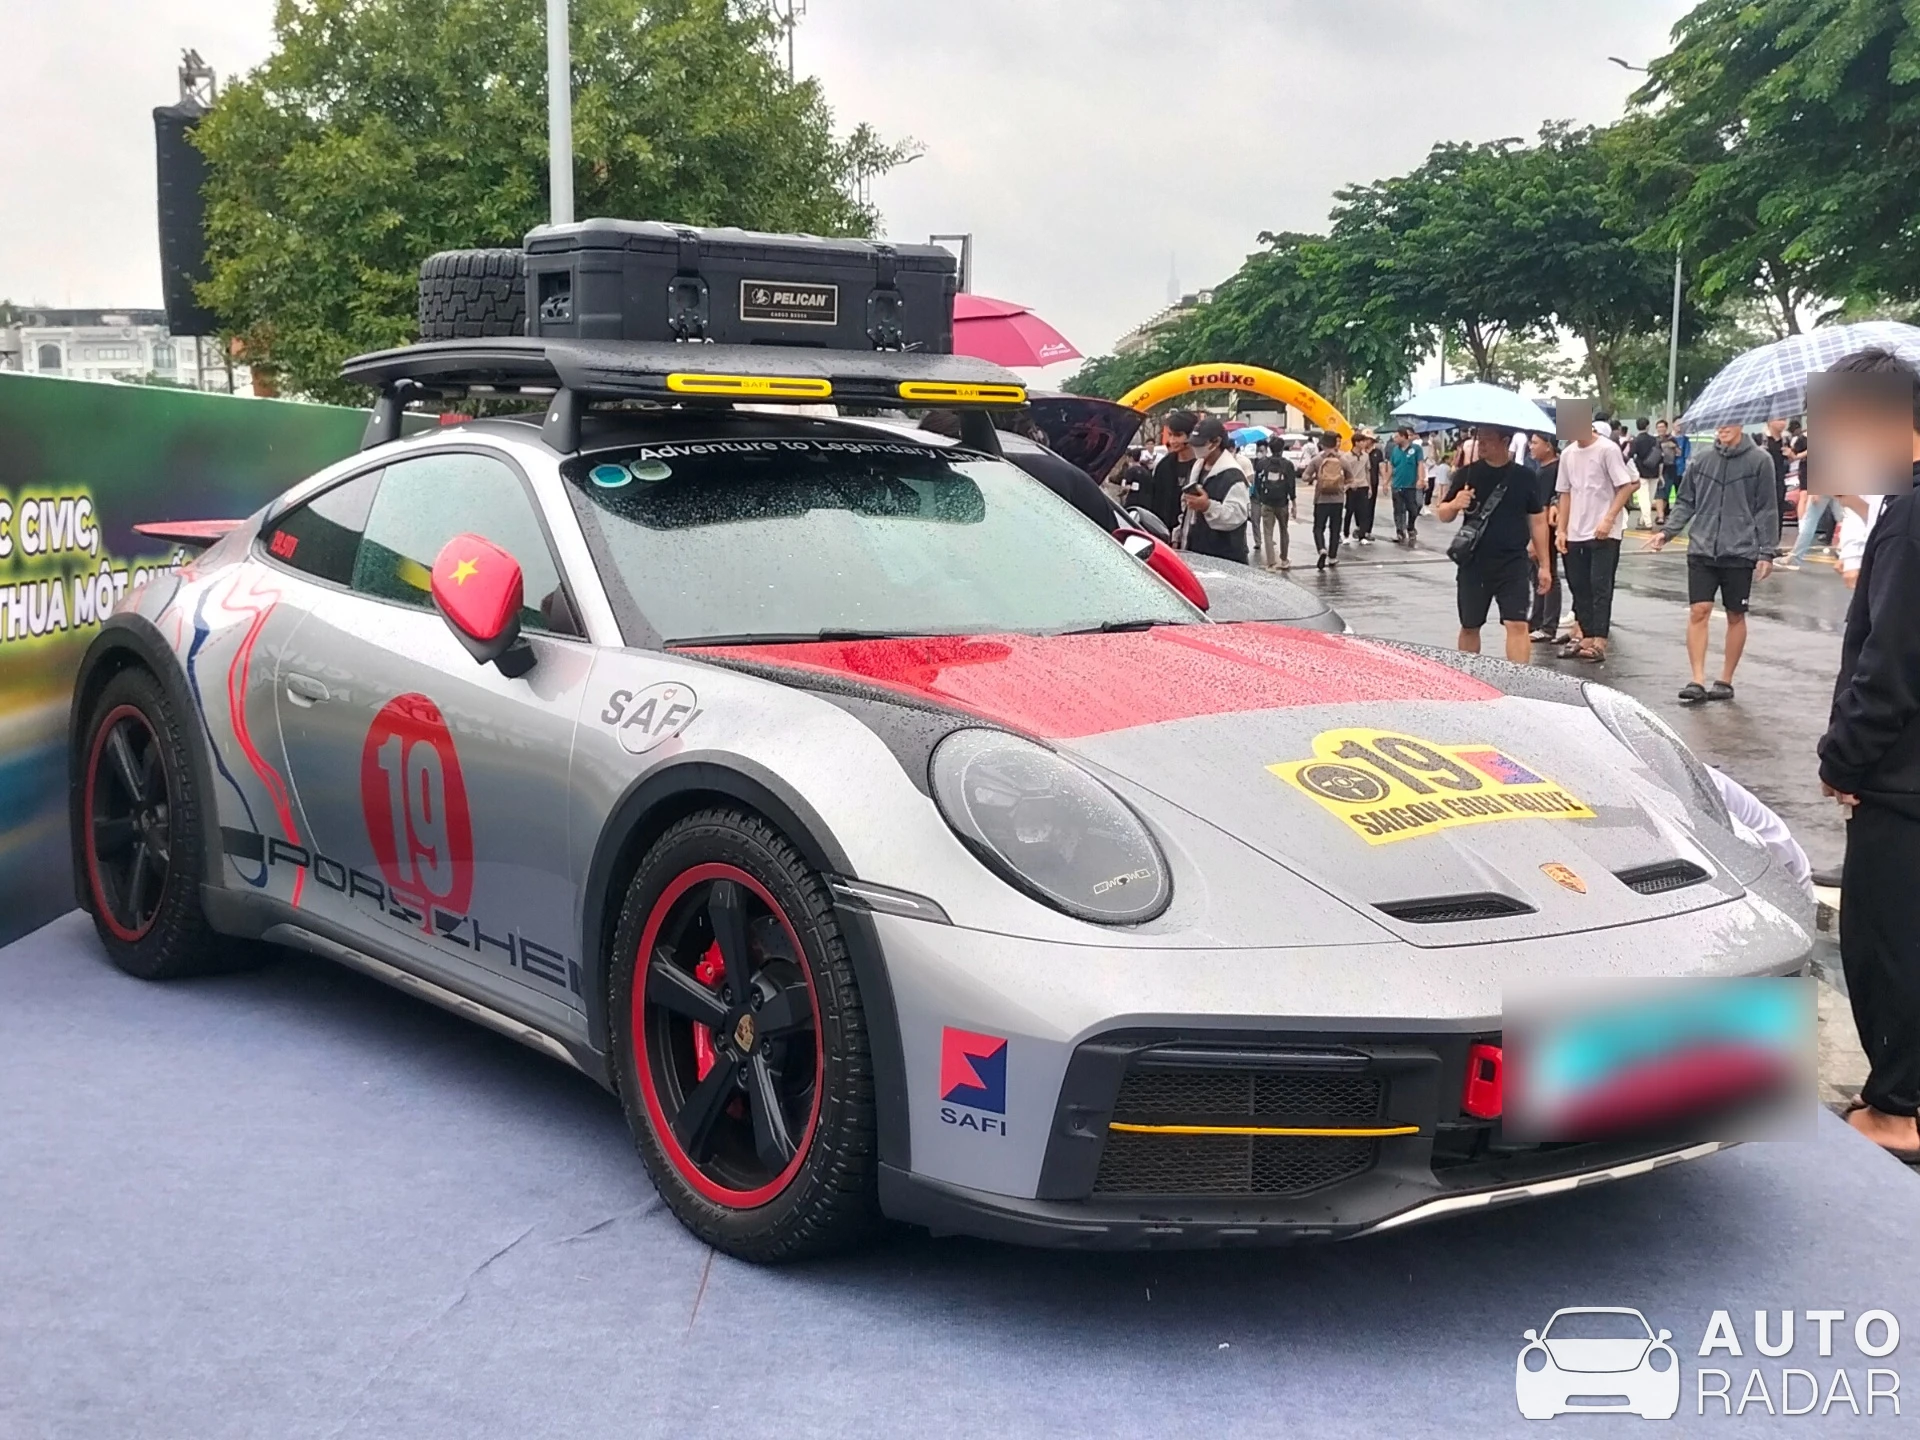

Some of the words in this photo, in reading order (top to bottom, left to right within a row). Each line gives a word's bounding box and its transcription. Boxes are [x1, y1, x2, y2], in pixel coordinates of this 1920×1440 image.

[773, 292, 826, 307] PELICAN
[742, 381, 769, 389] SAFI
[640, 442, 779, 461] Adventure
[780, 440, 810, 451] to
[811, 440, 937, 459] Legendary
[20, 496, 99, 557] CIVIC,
[600, 688, 705, 739] SAFI
[1330, 736, 1484, 796] 19
[377, 731, 454, 899] 19
[1349, 799, 1455, 837] SAIGON
[1440, 793, 1505, 818] GOBI
[940, 1107, 1007, 1137] SAFI
